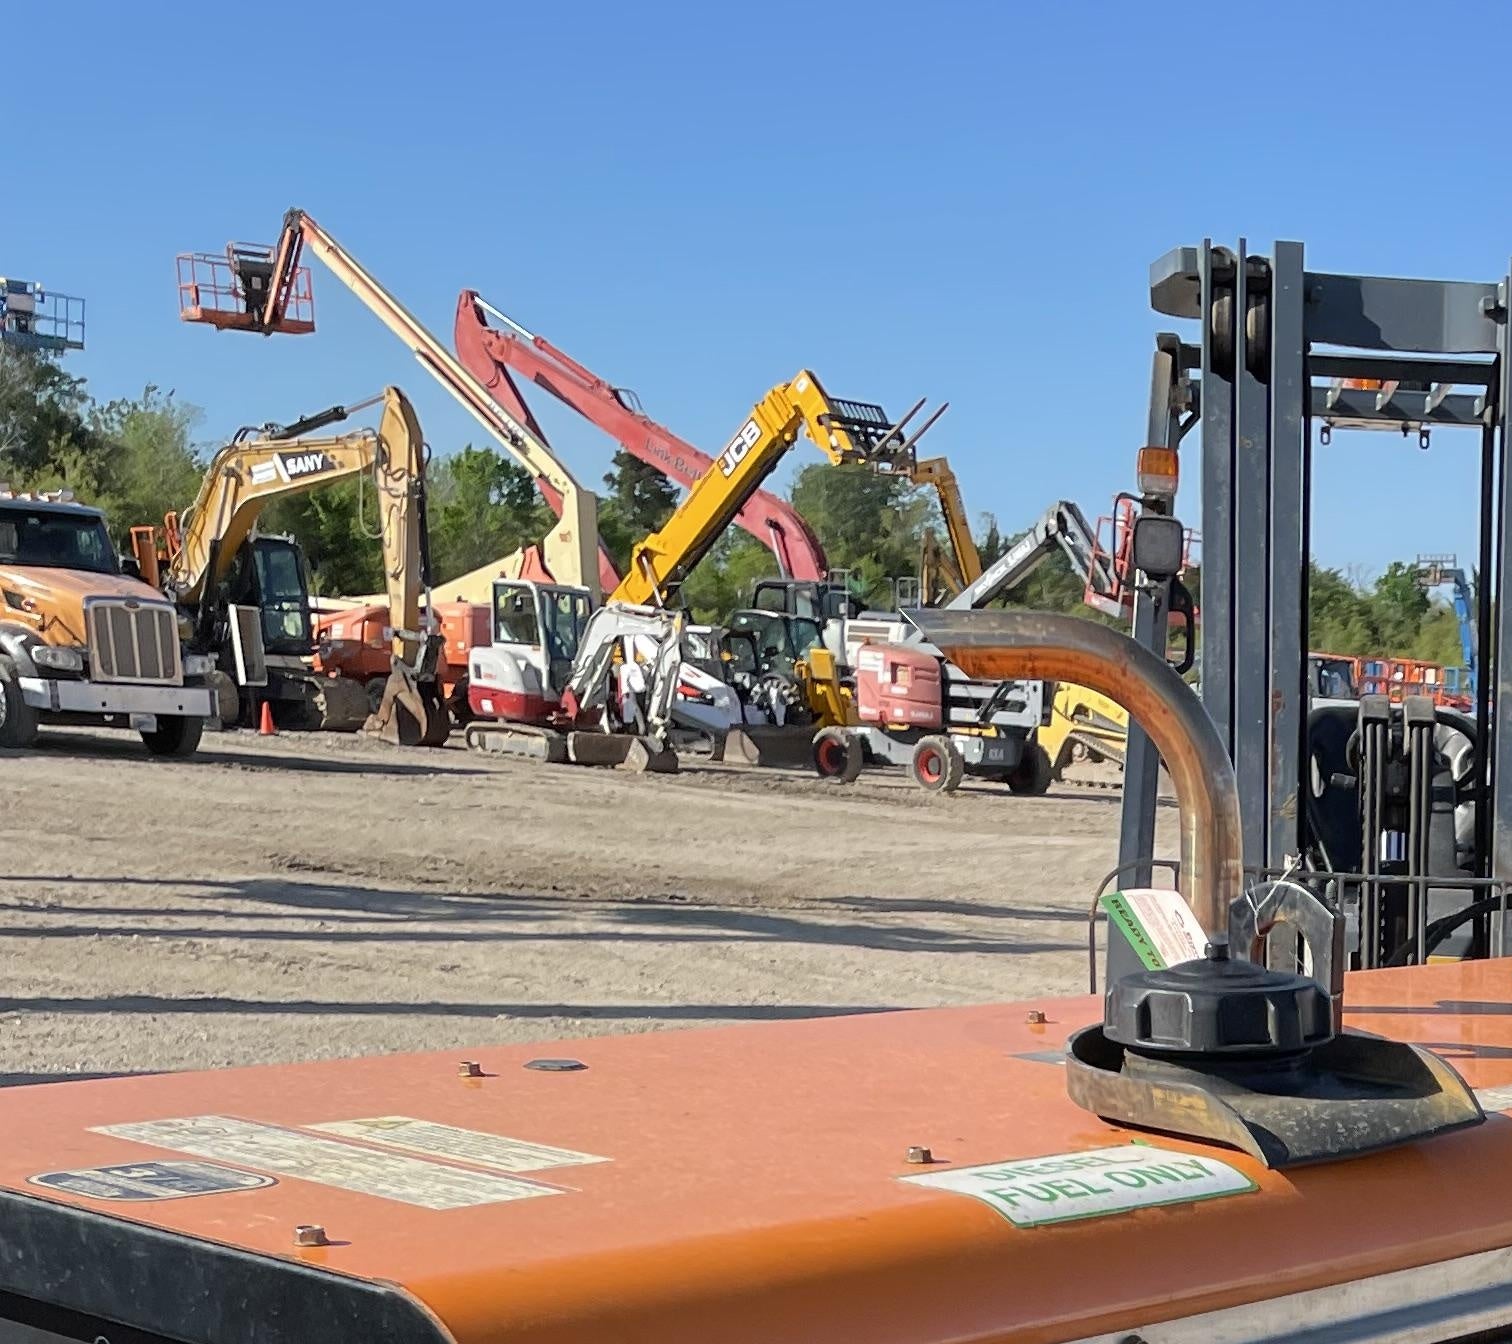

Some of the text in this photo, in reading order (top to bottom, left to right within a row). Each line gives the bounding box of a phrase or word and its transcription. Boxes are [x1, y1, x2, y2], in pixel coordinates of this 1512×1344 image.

[285, 453, 324, 475] SANY
[718, 419, 762, 478] JCB
[1112, 899, 1161, 967] READY TO
[971, 1155, 1116, 1182] DIESEL
[984, 1158, 1216, 1209] FUEL ONLY
